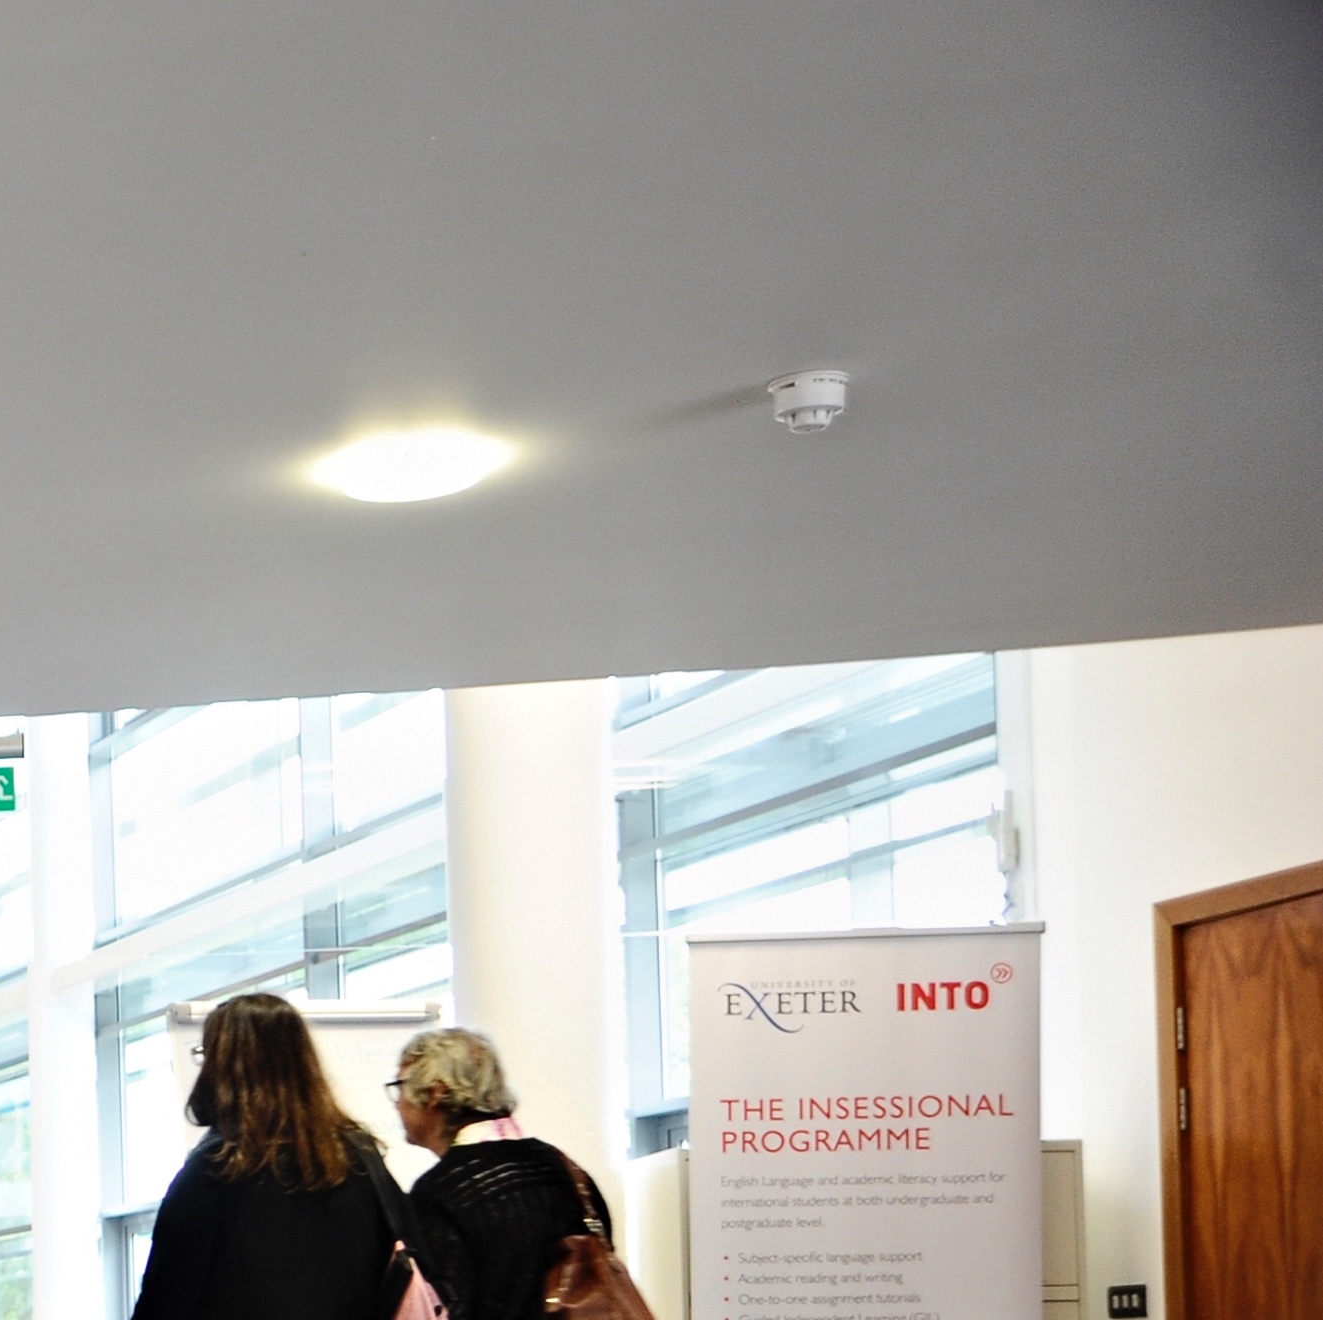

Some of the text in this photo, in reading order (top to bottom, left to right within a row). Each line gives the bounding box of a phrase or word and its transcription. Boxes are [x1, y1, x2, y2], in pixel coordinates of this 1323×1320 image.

[750, 979, 857, 990] UNIVERSITY OF
[896, 981, 989, 1011] INTO
[720, 986, 862, 1028] EXETER
[721, 1094, 1014, 1122] THE INSESSIONAL
[721, 1128, 931, 1153] PROGRAMME
[721, 1171, 1005, 1189] English Language and academic literacy support for
[721, 1192, 993, 1208] international students at both undergraduate and
[721, 1217, 793, 1230] postgraduate
[738, 1251, 922, 1266] Subject-specific language support
[738, 1272, 903, 1286] Academic reading and writing
[738, 1293, 921, 1306] One-to-one assignment tutorials
